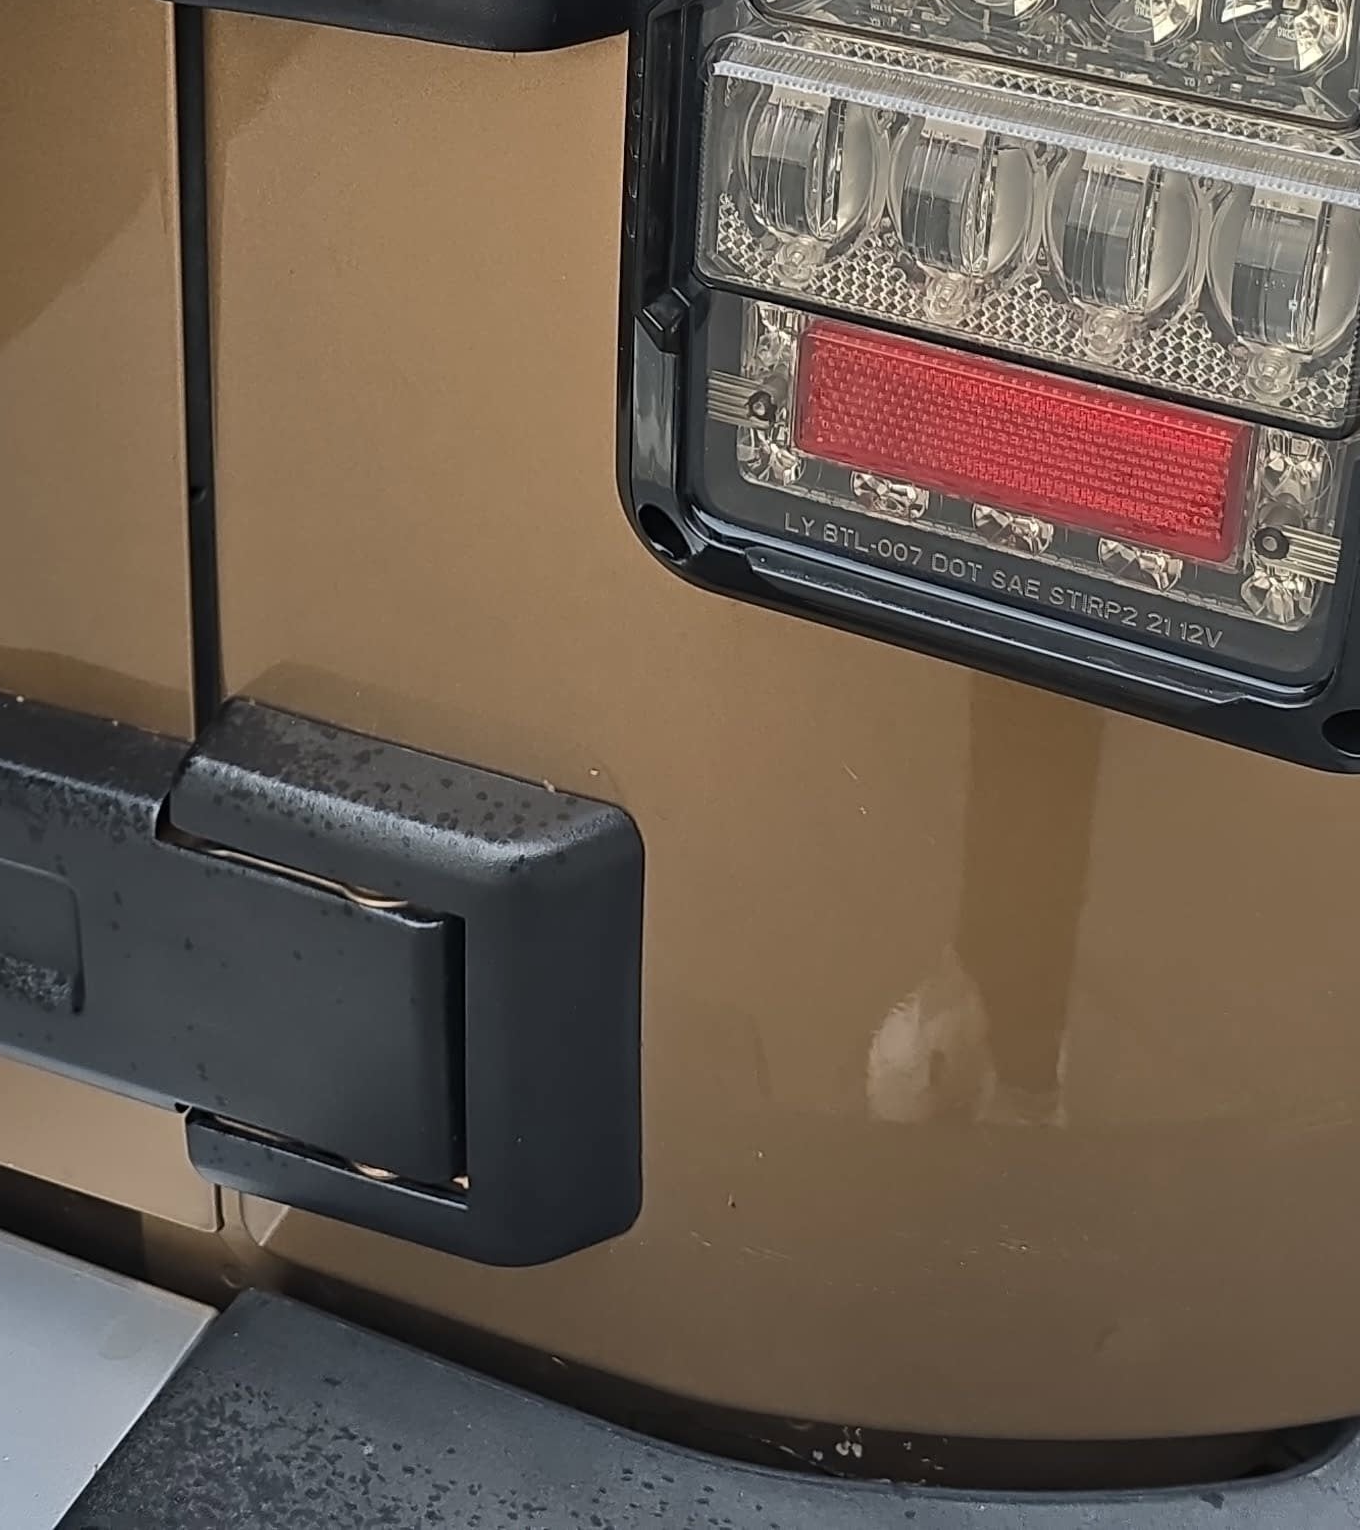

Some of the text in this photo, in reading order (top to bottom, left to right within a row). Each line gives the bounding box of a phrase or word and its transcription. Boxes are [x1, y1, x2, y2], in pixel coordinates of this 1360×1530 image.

[783, 512, 816, 537] LY
[931, 552, 983, 583] DOT
[991, 569, 1041, 600] SAE
[1048, 585, 1140, 627] STIRP2
[1179, 621, 1224, 649] 12V
